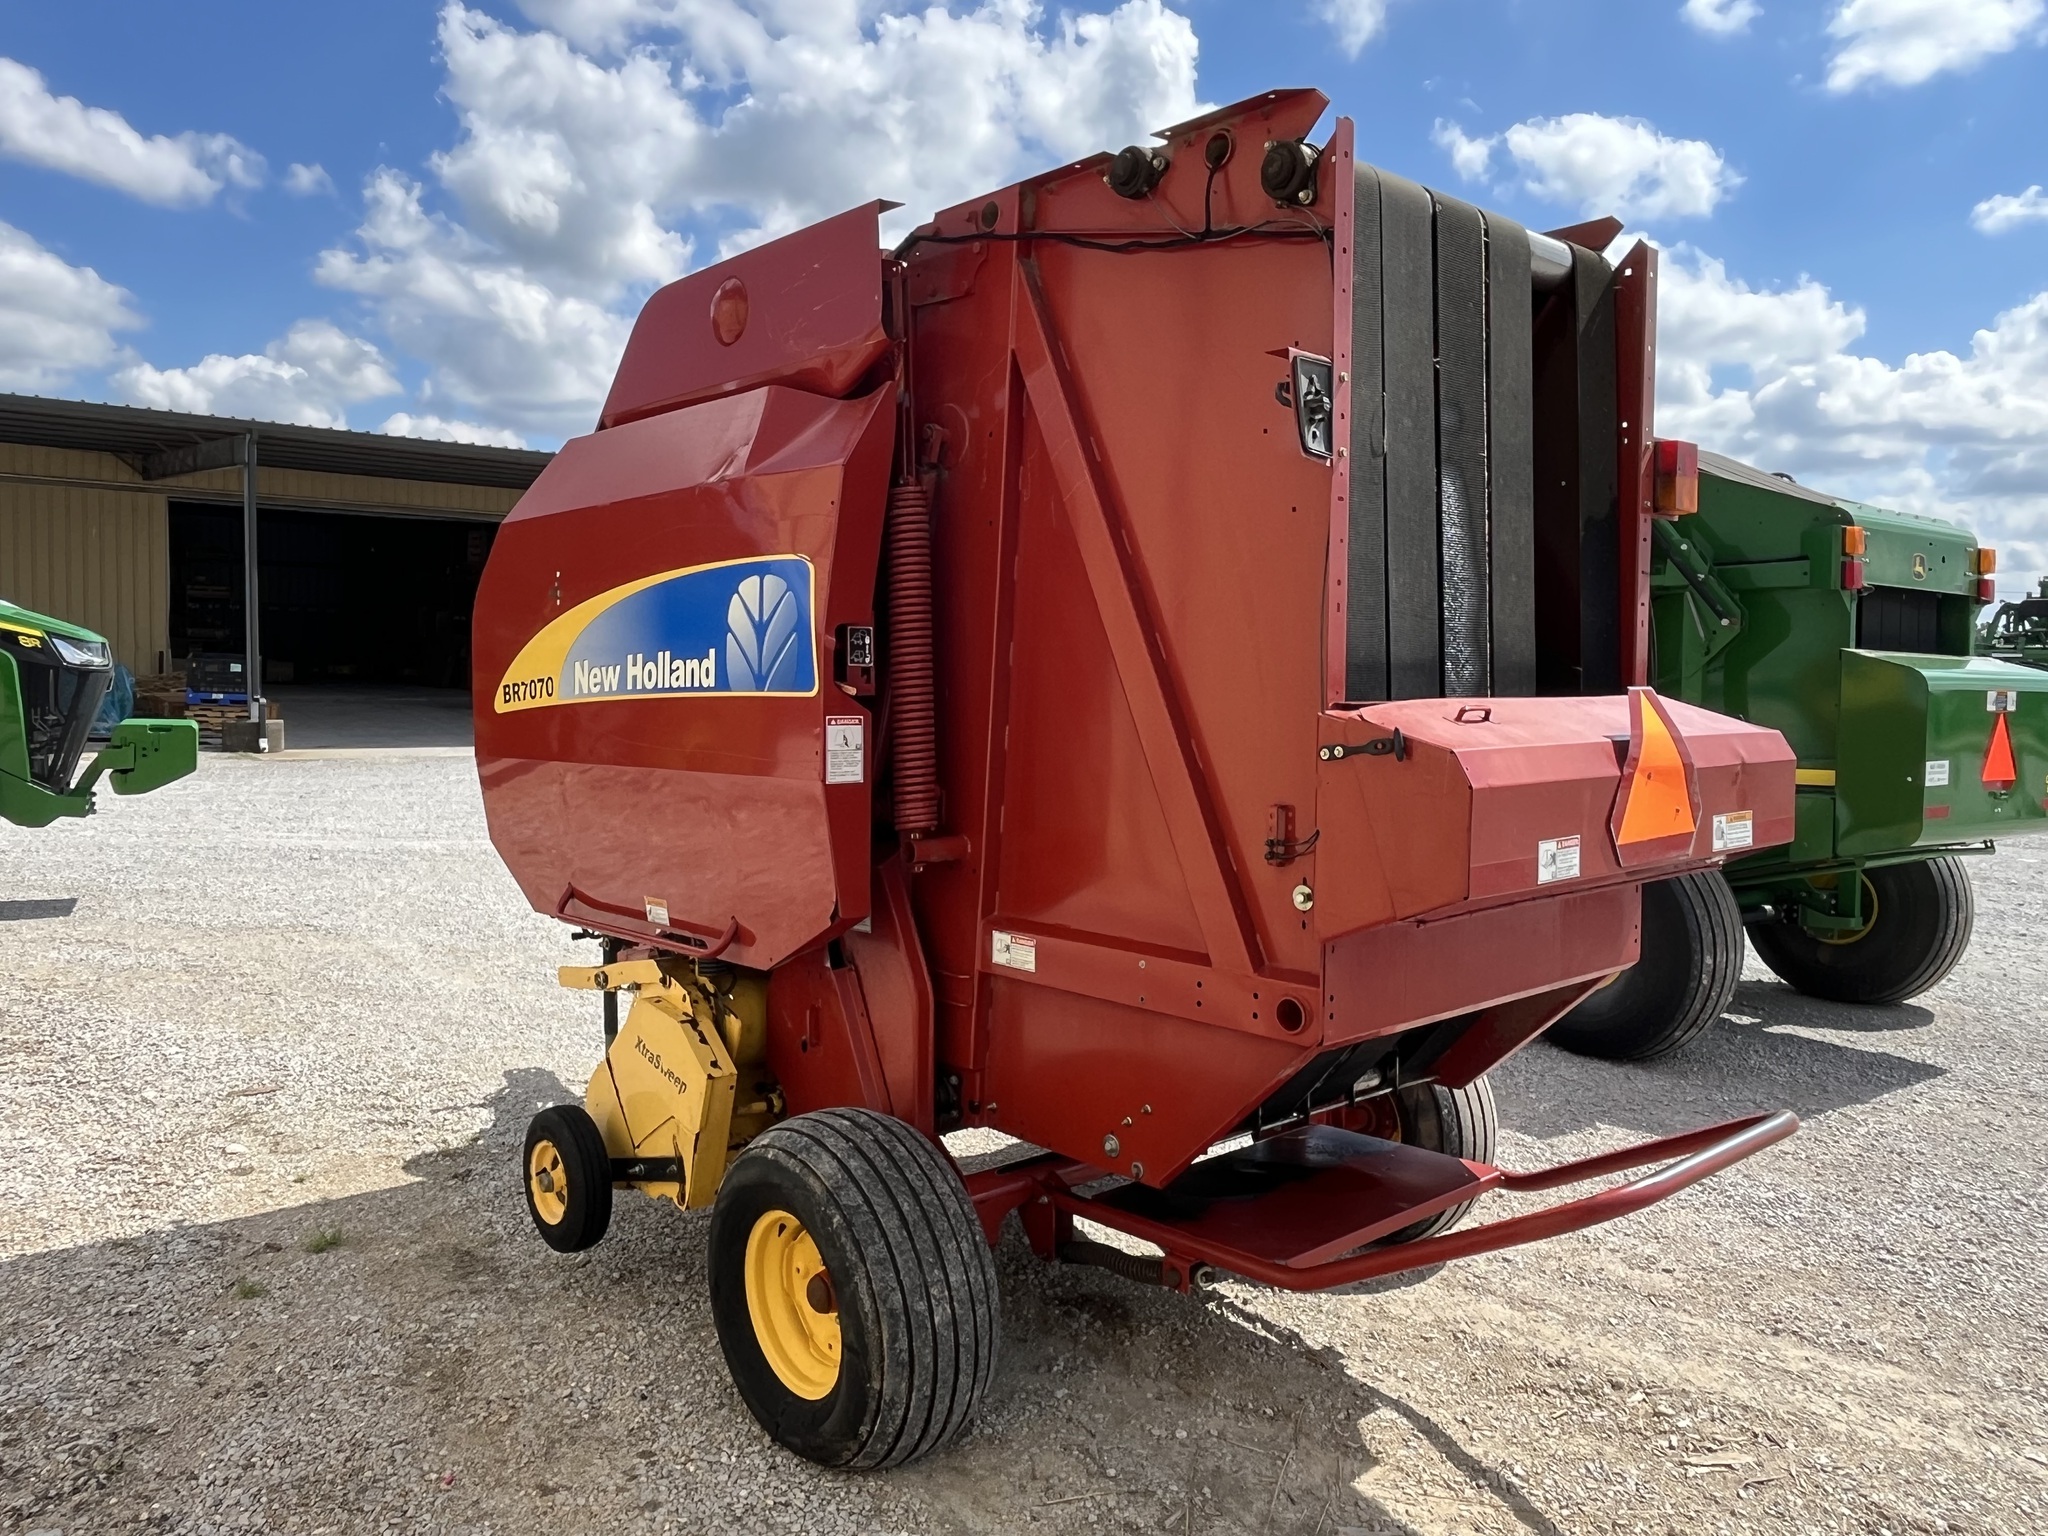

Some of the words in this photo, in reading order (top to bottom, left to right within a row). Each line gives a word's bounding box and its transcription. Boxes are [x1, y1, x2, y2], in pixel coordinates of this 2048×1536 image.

[503, 676, 554, 704] BR7070
[574, 659, 620, 695] New
[626, 648, 716, 690] Holland
